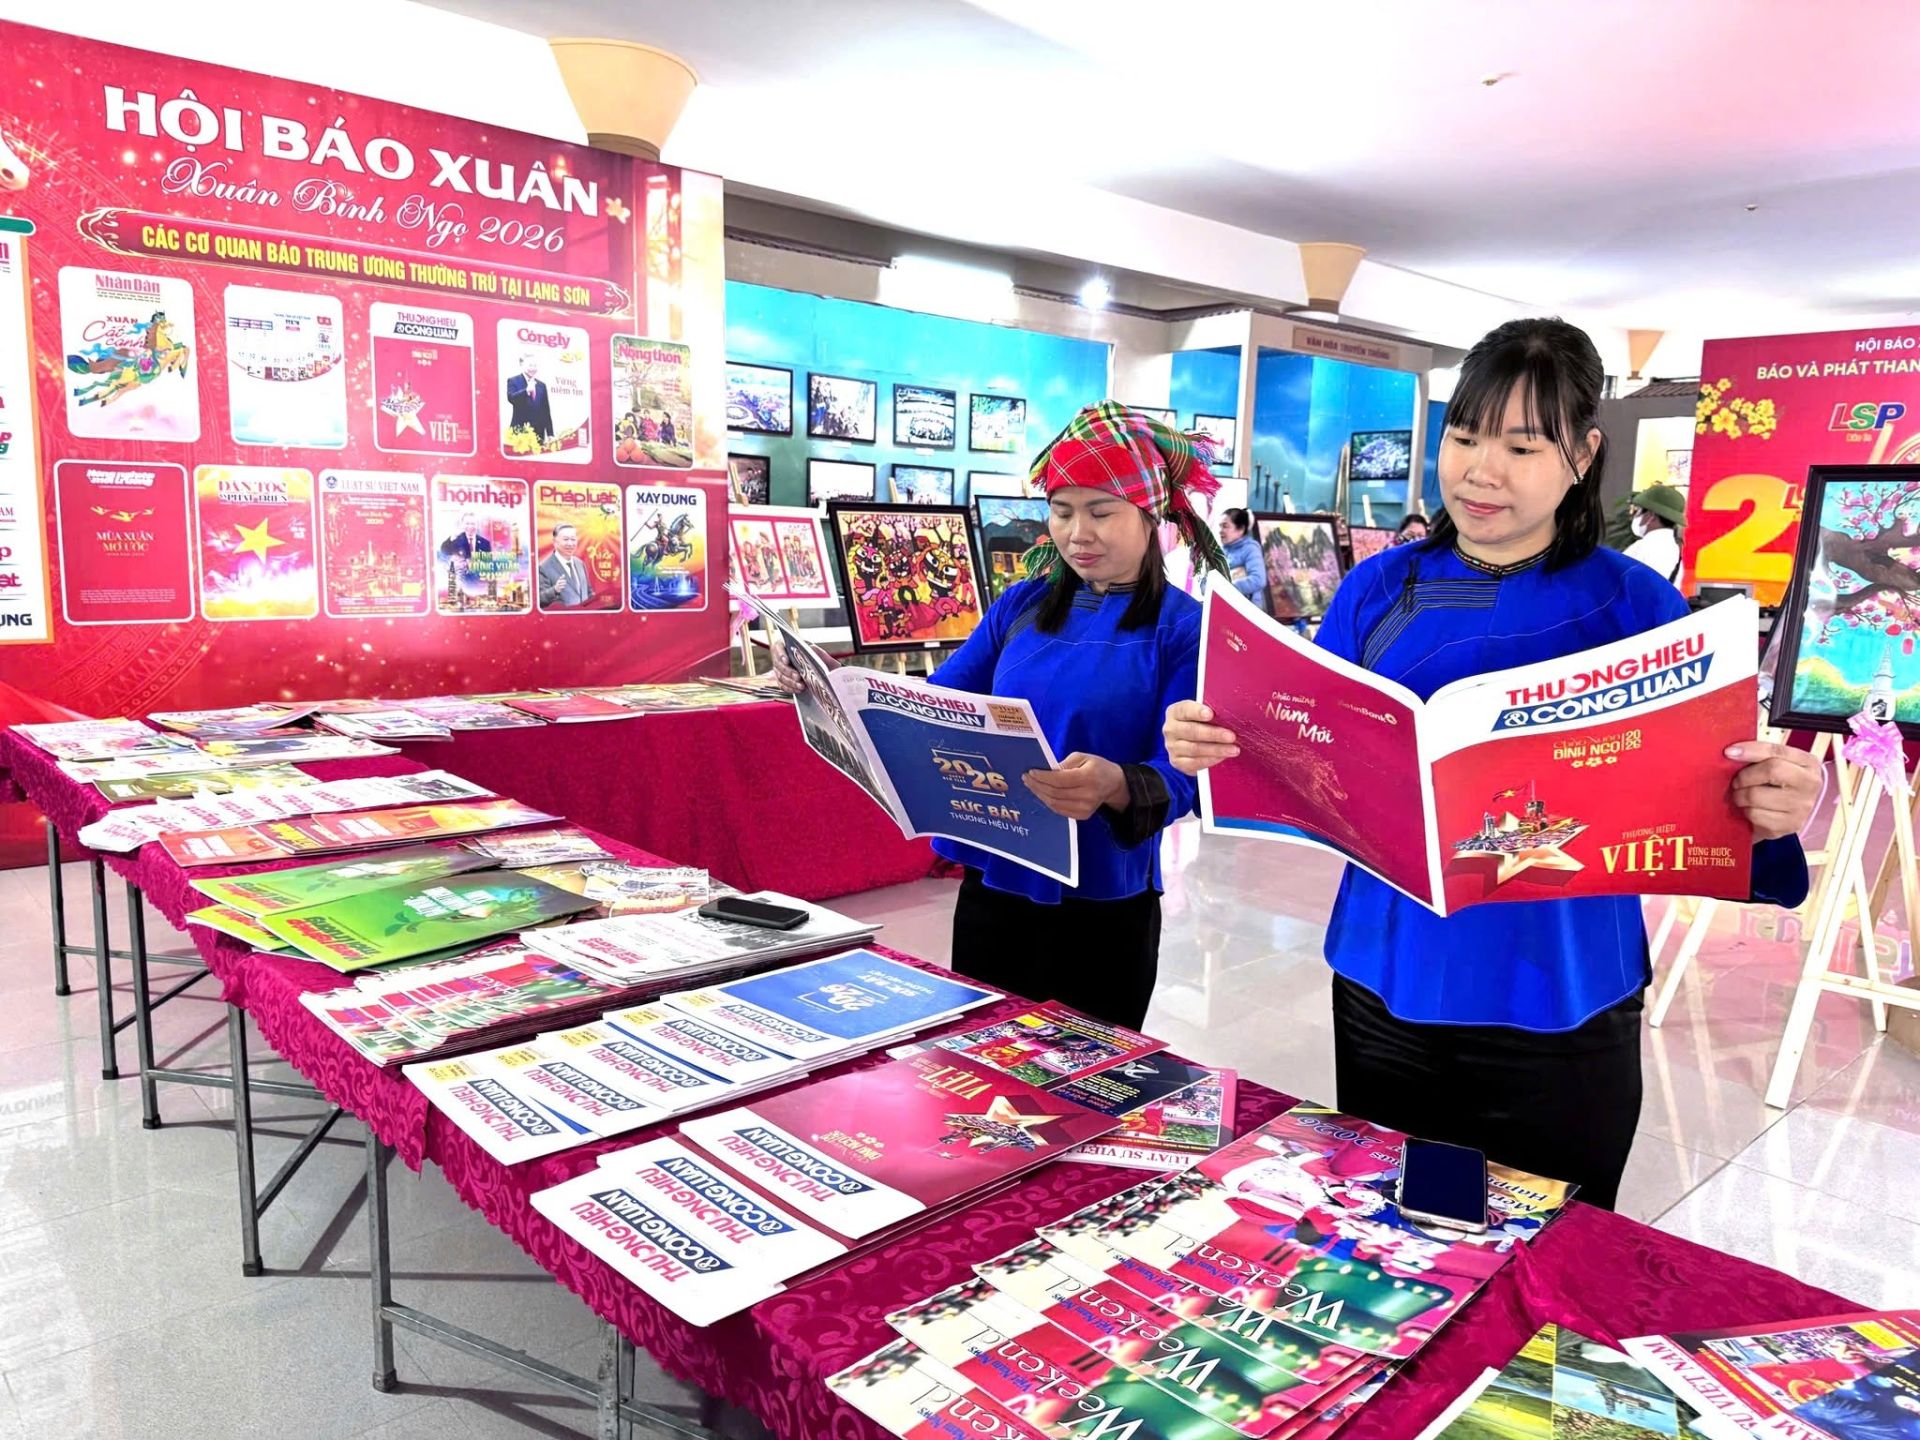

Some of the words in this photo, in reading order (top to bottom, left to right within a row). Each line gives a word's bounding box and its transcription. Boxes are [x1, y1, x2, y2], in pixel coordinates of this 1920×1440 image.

[103, 85, 244, 152] HỘI
[262, 116, 415, 180] BÁO
[428, 147, 598, 217] XUÂN
[161, 157, 282, 207] Xuân
[397, 195, 469, 248] Ngọ
[476, 216, 566, 252] 2026
[142, 224, 180, 250] CÁC
[185, 232, 210, 254] CƠ
[214, 235, 262, 261] QUAN
[267, 237, 301, 266] BÁO
[306, 247, 358, 274] TRUNG
[364, 255, 406, 280] ƯƠNG
[409, 261, 467, 288] THƯỜNG
[471, 268, 497, 294] TRÚ
[500, 276, 522, 299] TẠI
[525, 281, 560, 305] LẠNG
[564, 285, 590, 307] SƠN
[1855, 337, 1881, 353] HỘI
[1884, 335, 1915, 350] BÁO
[1756, 362, 1793, 380] BÁO
[1795, 363, 1820, 378] VÀ
[1823, 359, 1870, 377] PHÁT
[1829, 402, 1905, 431] LSP
[1265, 701, 1310, 723] Năm
[1297, 724, 1335, 744] Mới
[1625, 729, 1641, 741] 20
[1625, 739, 1642, 750] 26
[950, 799, 985, 815] SỨC
[1009, 823, 1030, 837] VIỆT
[1599, 833, 1694, 877] VIỆT
[1297, 1116, 1383, 1149] 2026
[1162, 1233, 1344, 1331] Weekend
[1044, 1274, 1220, 1393] Weekend
[1645, 1341, 1692, 1373] NAM
[960, 1325, 1144, 1440] Weekend
